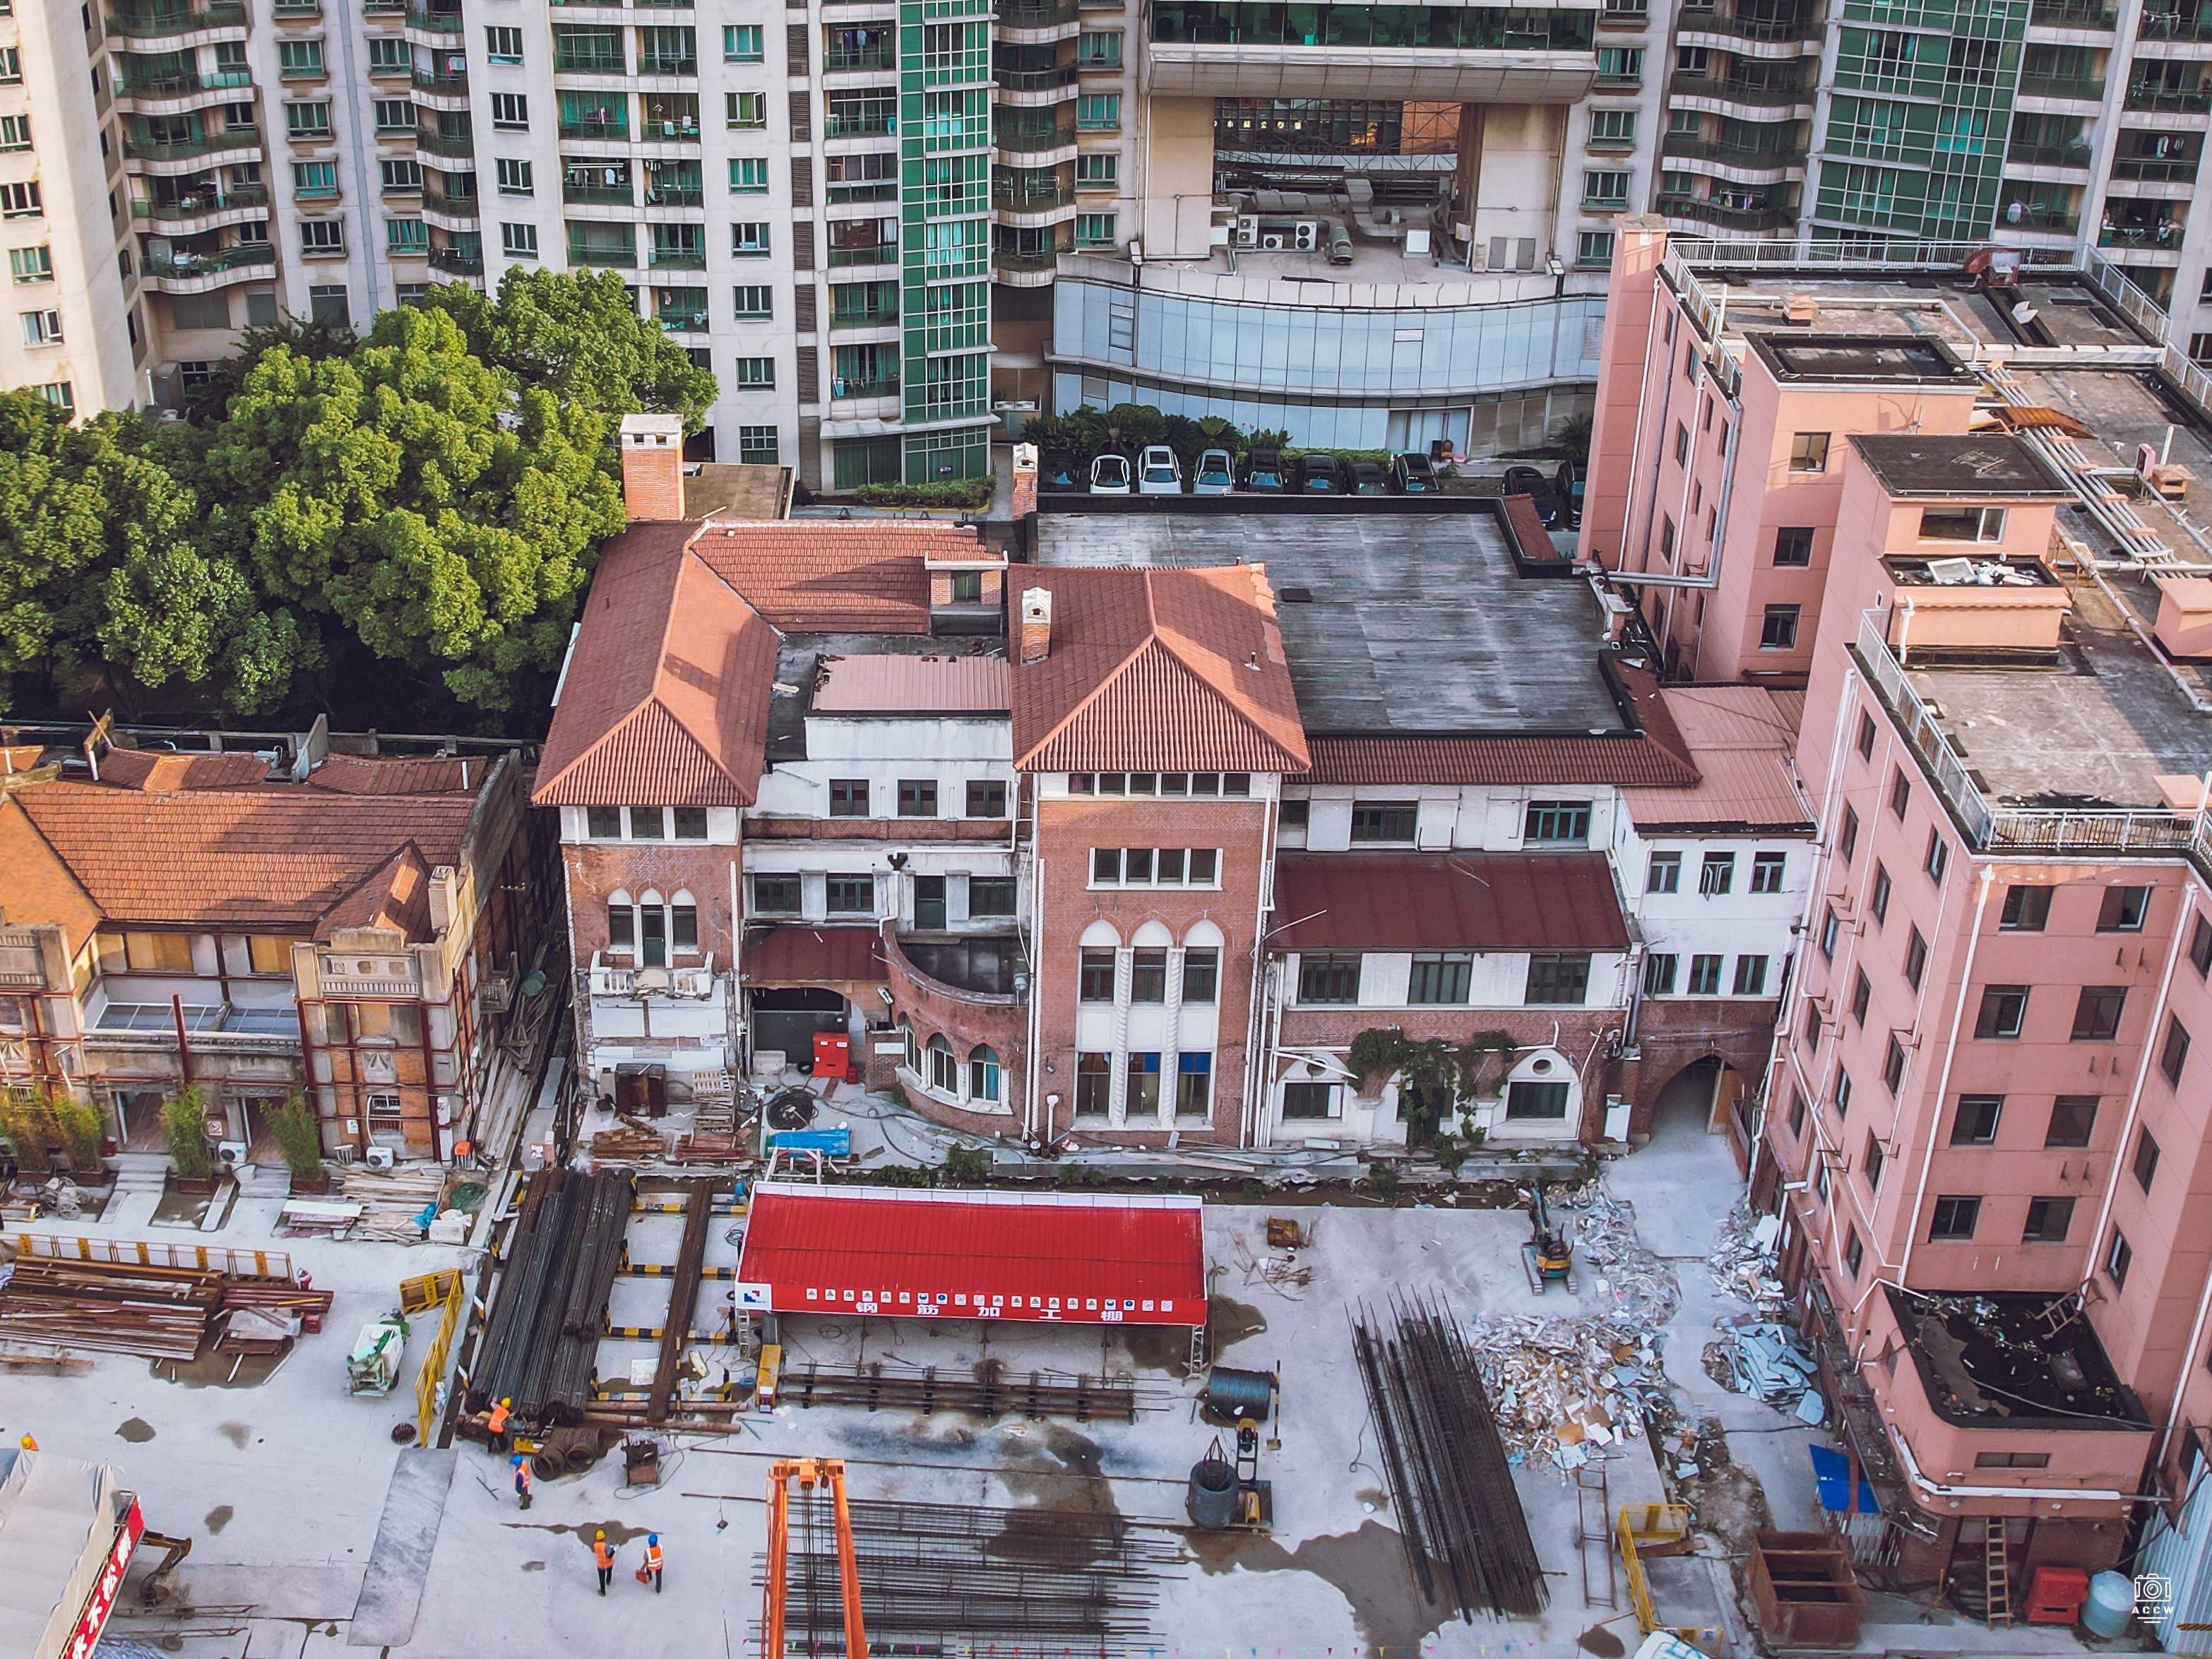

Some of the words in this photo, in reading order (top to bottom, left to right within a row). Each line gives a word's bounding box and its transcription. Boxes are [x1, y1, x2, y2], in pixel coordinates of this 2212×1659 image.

[855, 1301, 1124, 1321] 钢筋加工棚
